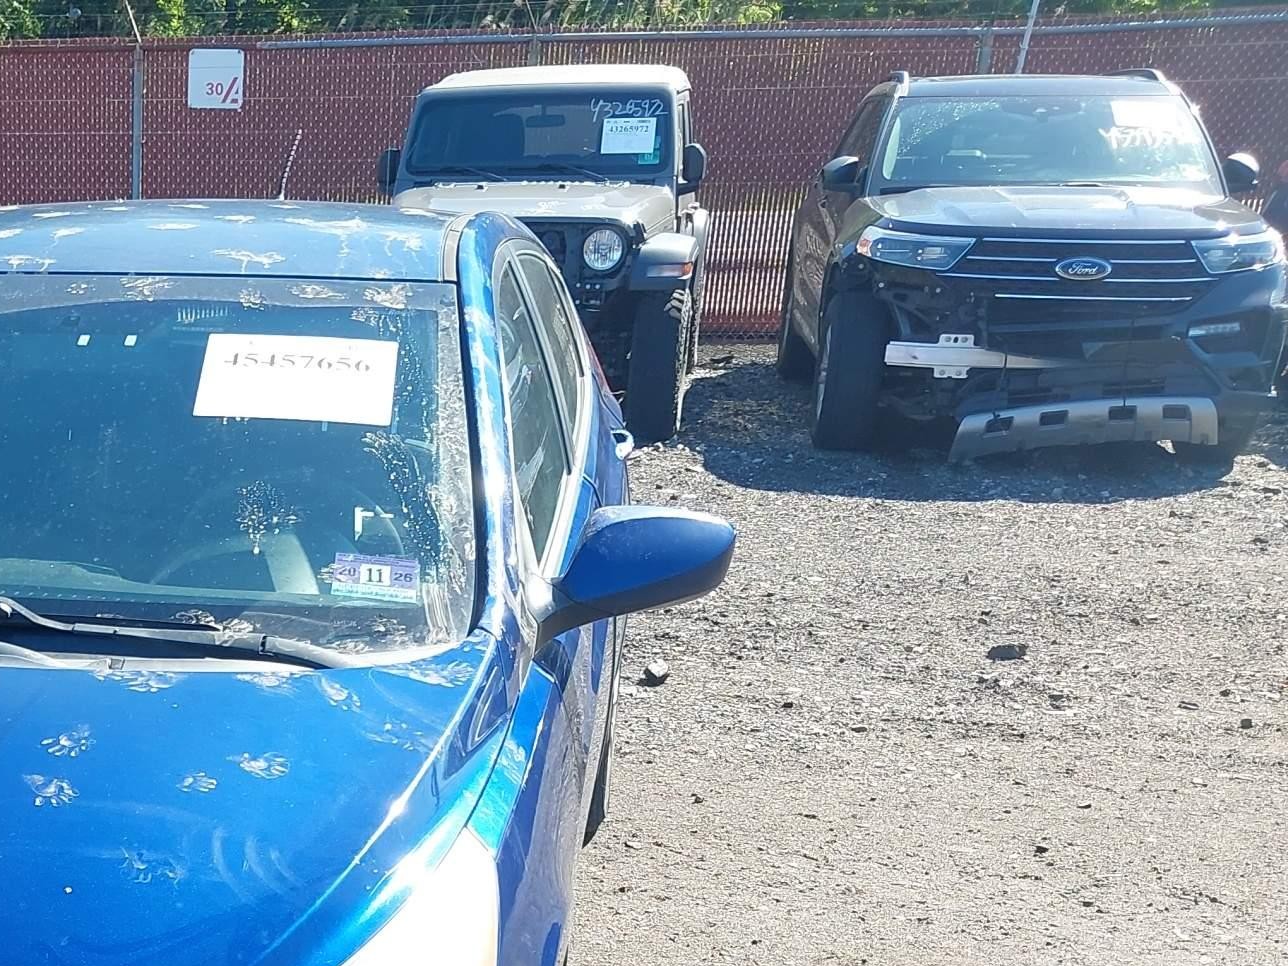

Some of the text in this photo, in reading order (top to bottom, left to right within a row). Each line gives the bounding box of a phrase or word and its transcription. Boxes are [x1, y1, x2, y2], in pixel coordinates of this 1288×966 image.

[608, 125, 650, 134] 43265972
[1068, 262, 1098, 275] Ford
[365, 567, 384, 583] 11
[393, 571, 413, 583] 26
